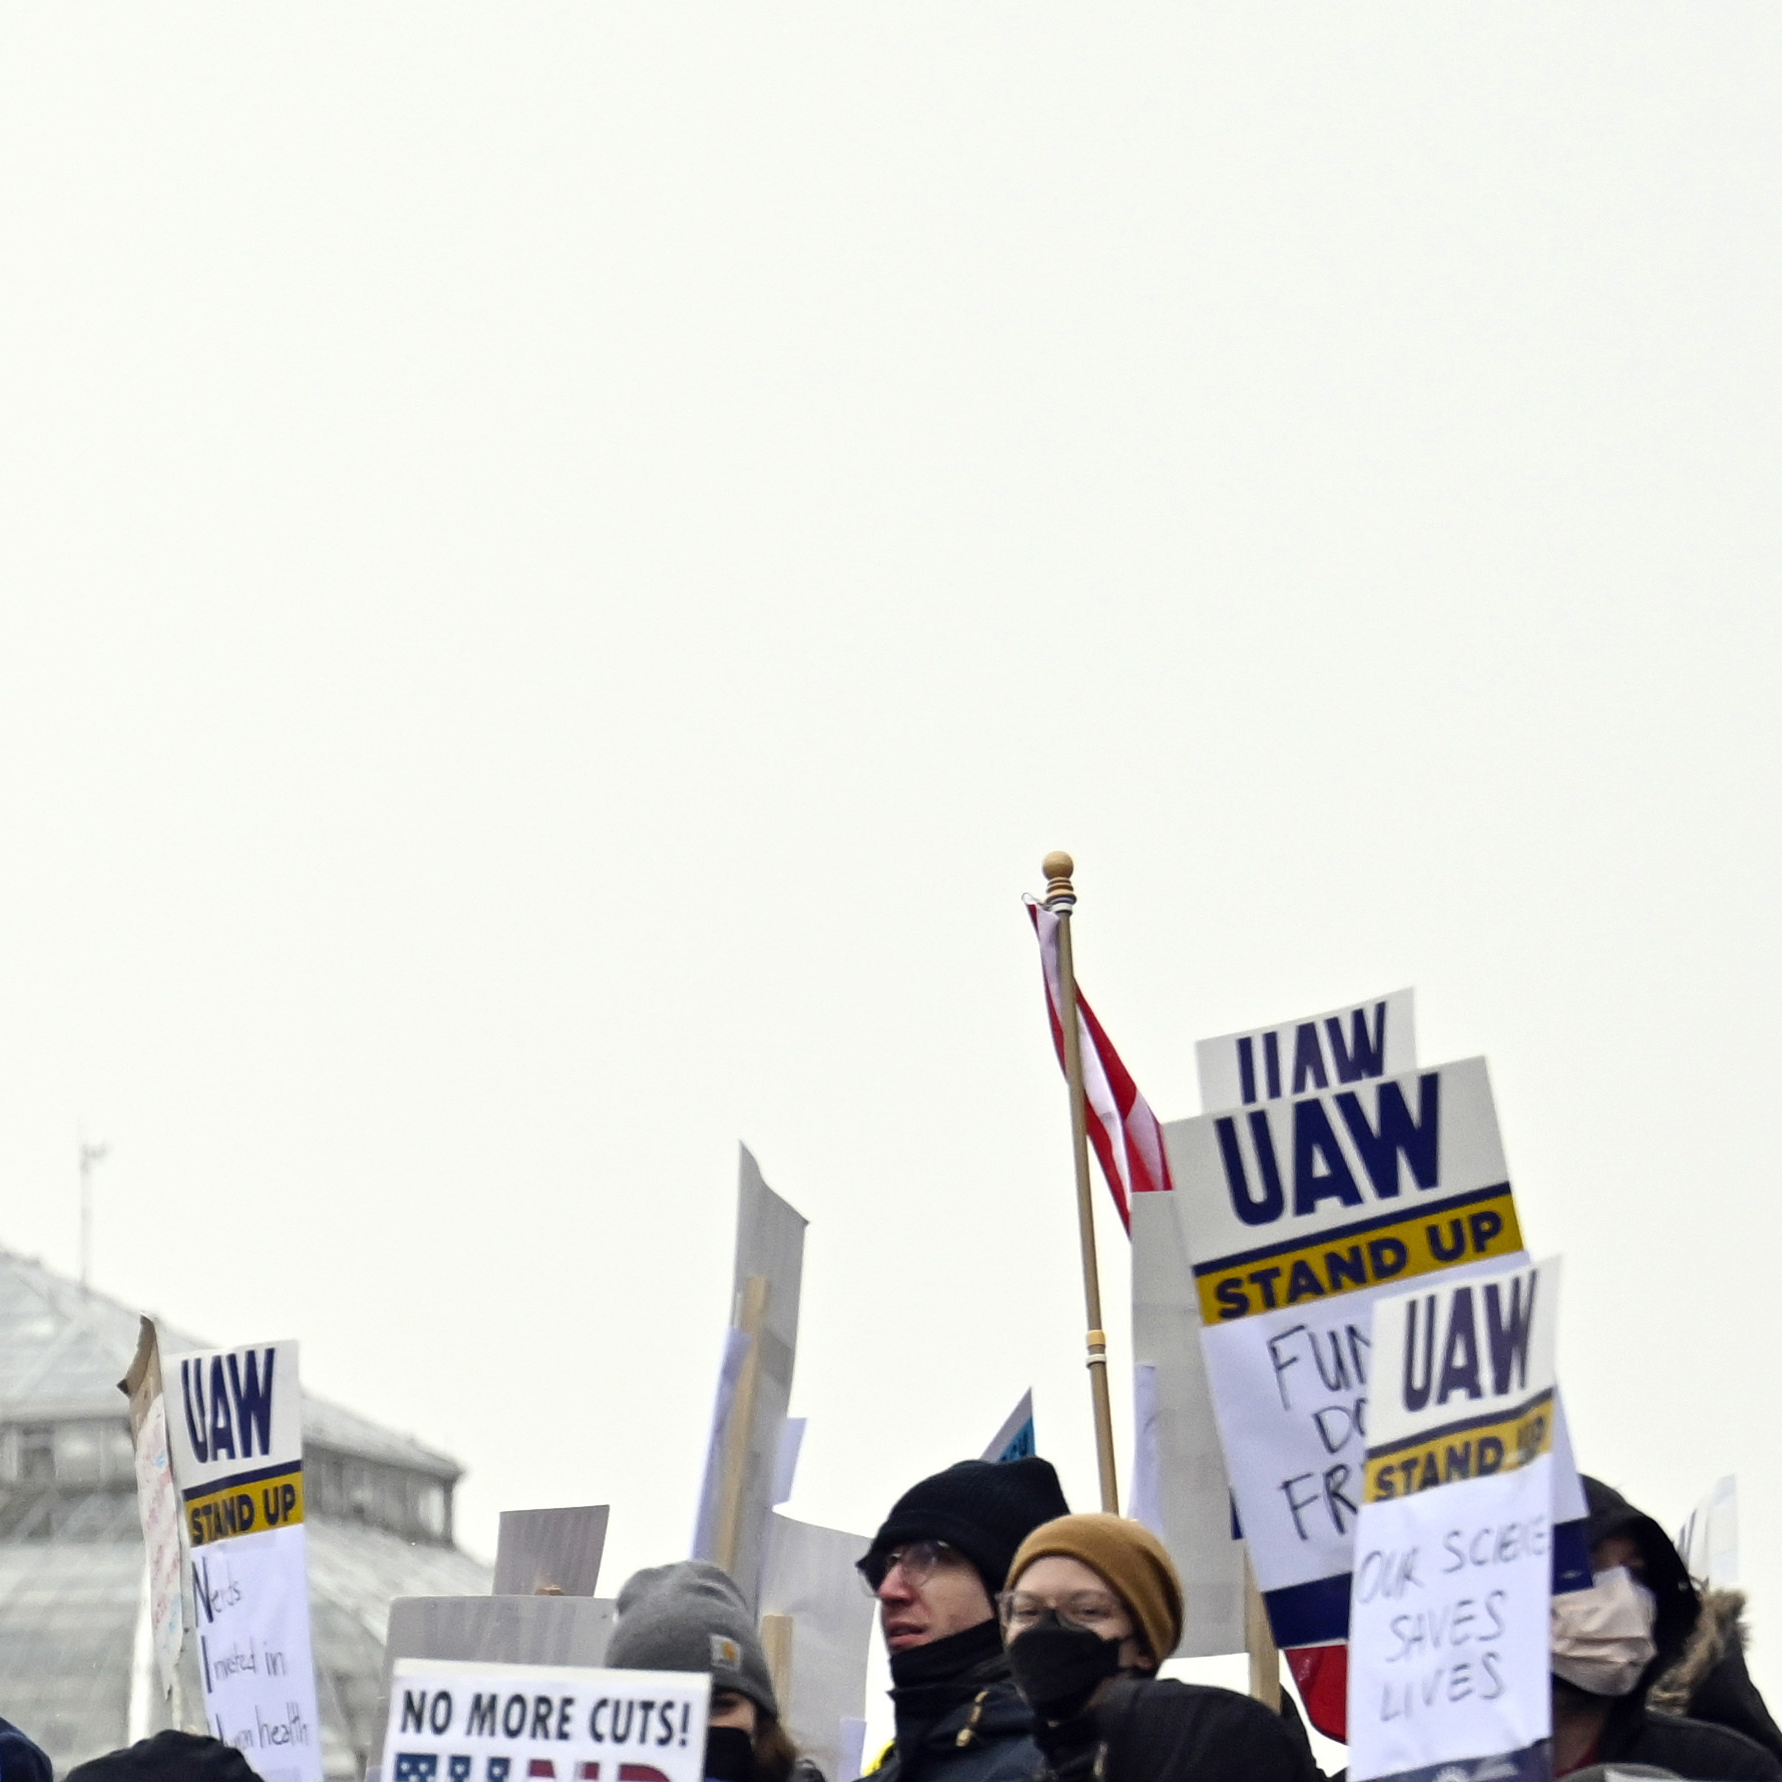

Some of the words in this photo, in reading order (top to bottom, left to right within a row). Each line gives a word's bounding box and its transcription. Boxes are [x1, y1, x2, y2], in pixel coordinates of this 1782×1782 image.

[1214, 1072, 1440, 1227] UAW
[1214, 1232, 1407, 1322] STAND
[1429, 1209, 1504, 1264] UP
[1403, 1270, 1538, 1416] UAW
[180, 1347, 275, 1463] UAW
[1375, 1436, 1504, 1502] STAND
[190, 1493, 254, 1546] STAND
[263, 1483, 296, 1527] UP
[1386, 1589, 1507, 1663] SAVES
[400, 1690, 453, 1735] NO
[466, 1694, 576, 1742] MORE
[589, 1697, 691, 1747] CUTS!
[1380, 1651, 1505, 1721] LIVES
